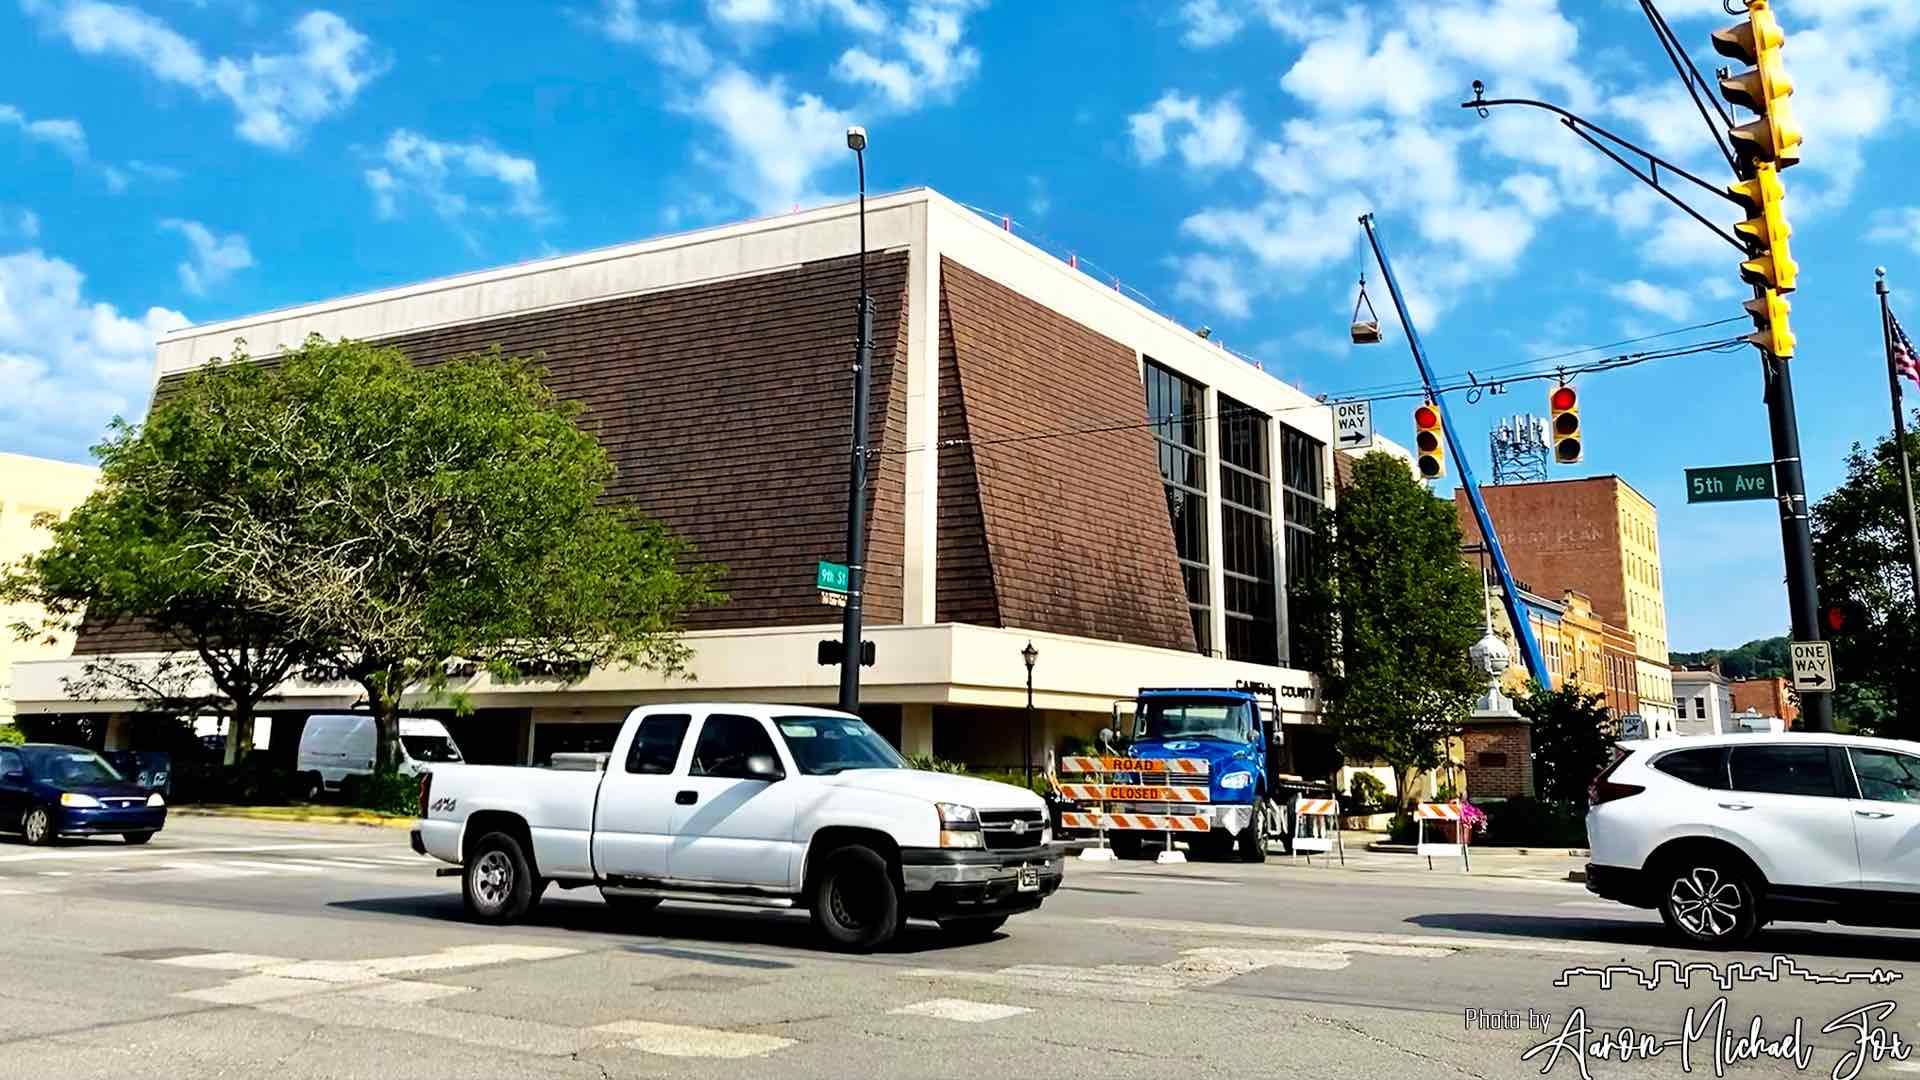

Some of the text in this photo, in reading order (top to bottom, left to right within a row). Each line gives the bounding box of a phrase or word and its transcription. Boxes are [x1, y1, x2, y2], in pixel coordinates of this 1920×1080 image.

[1339, 404, 1364, 416] ONE
[1338, 417, 1365, 429] WAY
[1694, 475, 1765, 494] 5th Ave
[822, 568, 847, 585] 9th St
[1795, 646, 1825, 658] ONE
[1795, 659, 1826, 671] WAY
[1281, 685, 1316, 699] COUNTY
[1113, 759, 1153, 770] ROAD
[1111, 787, 1158, 799] CLOSED
